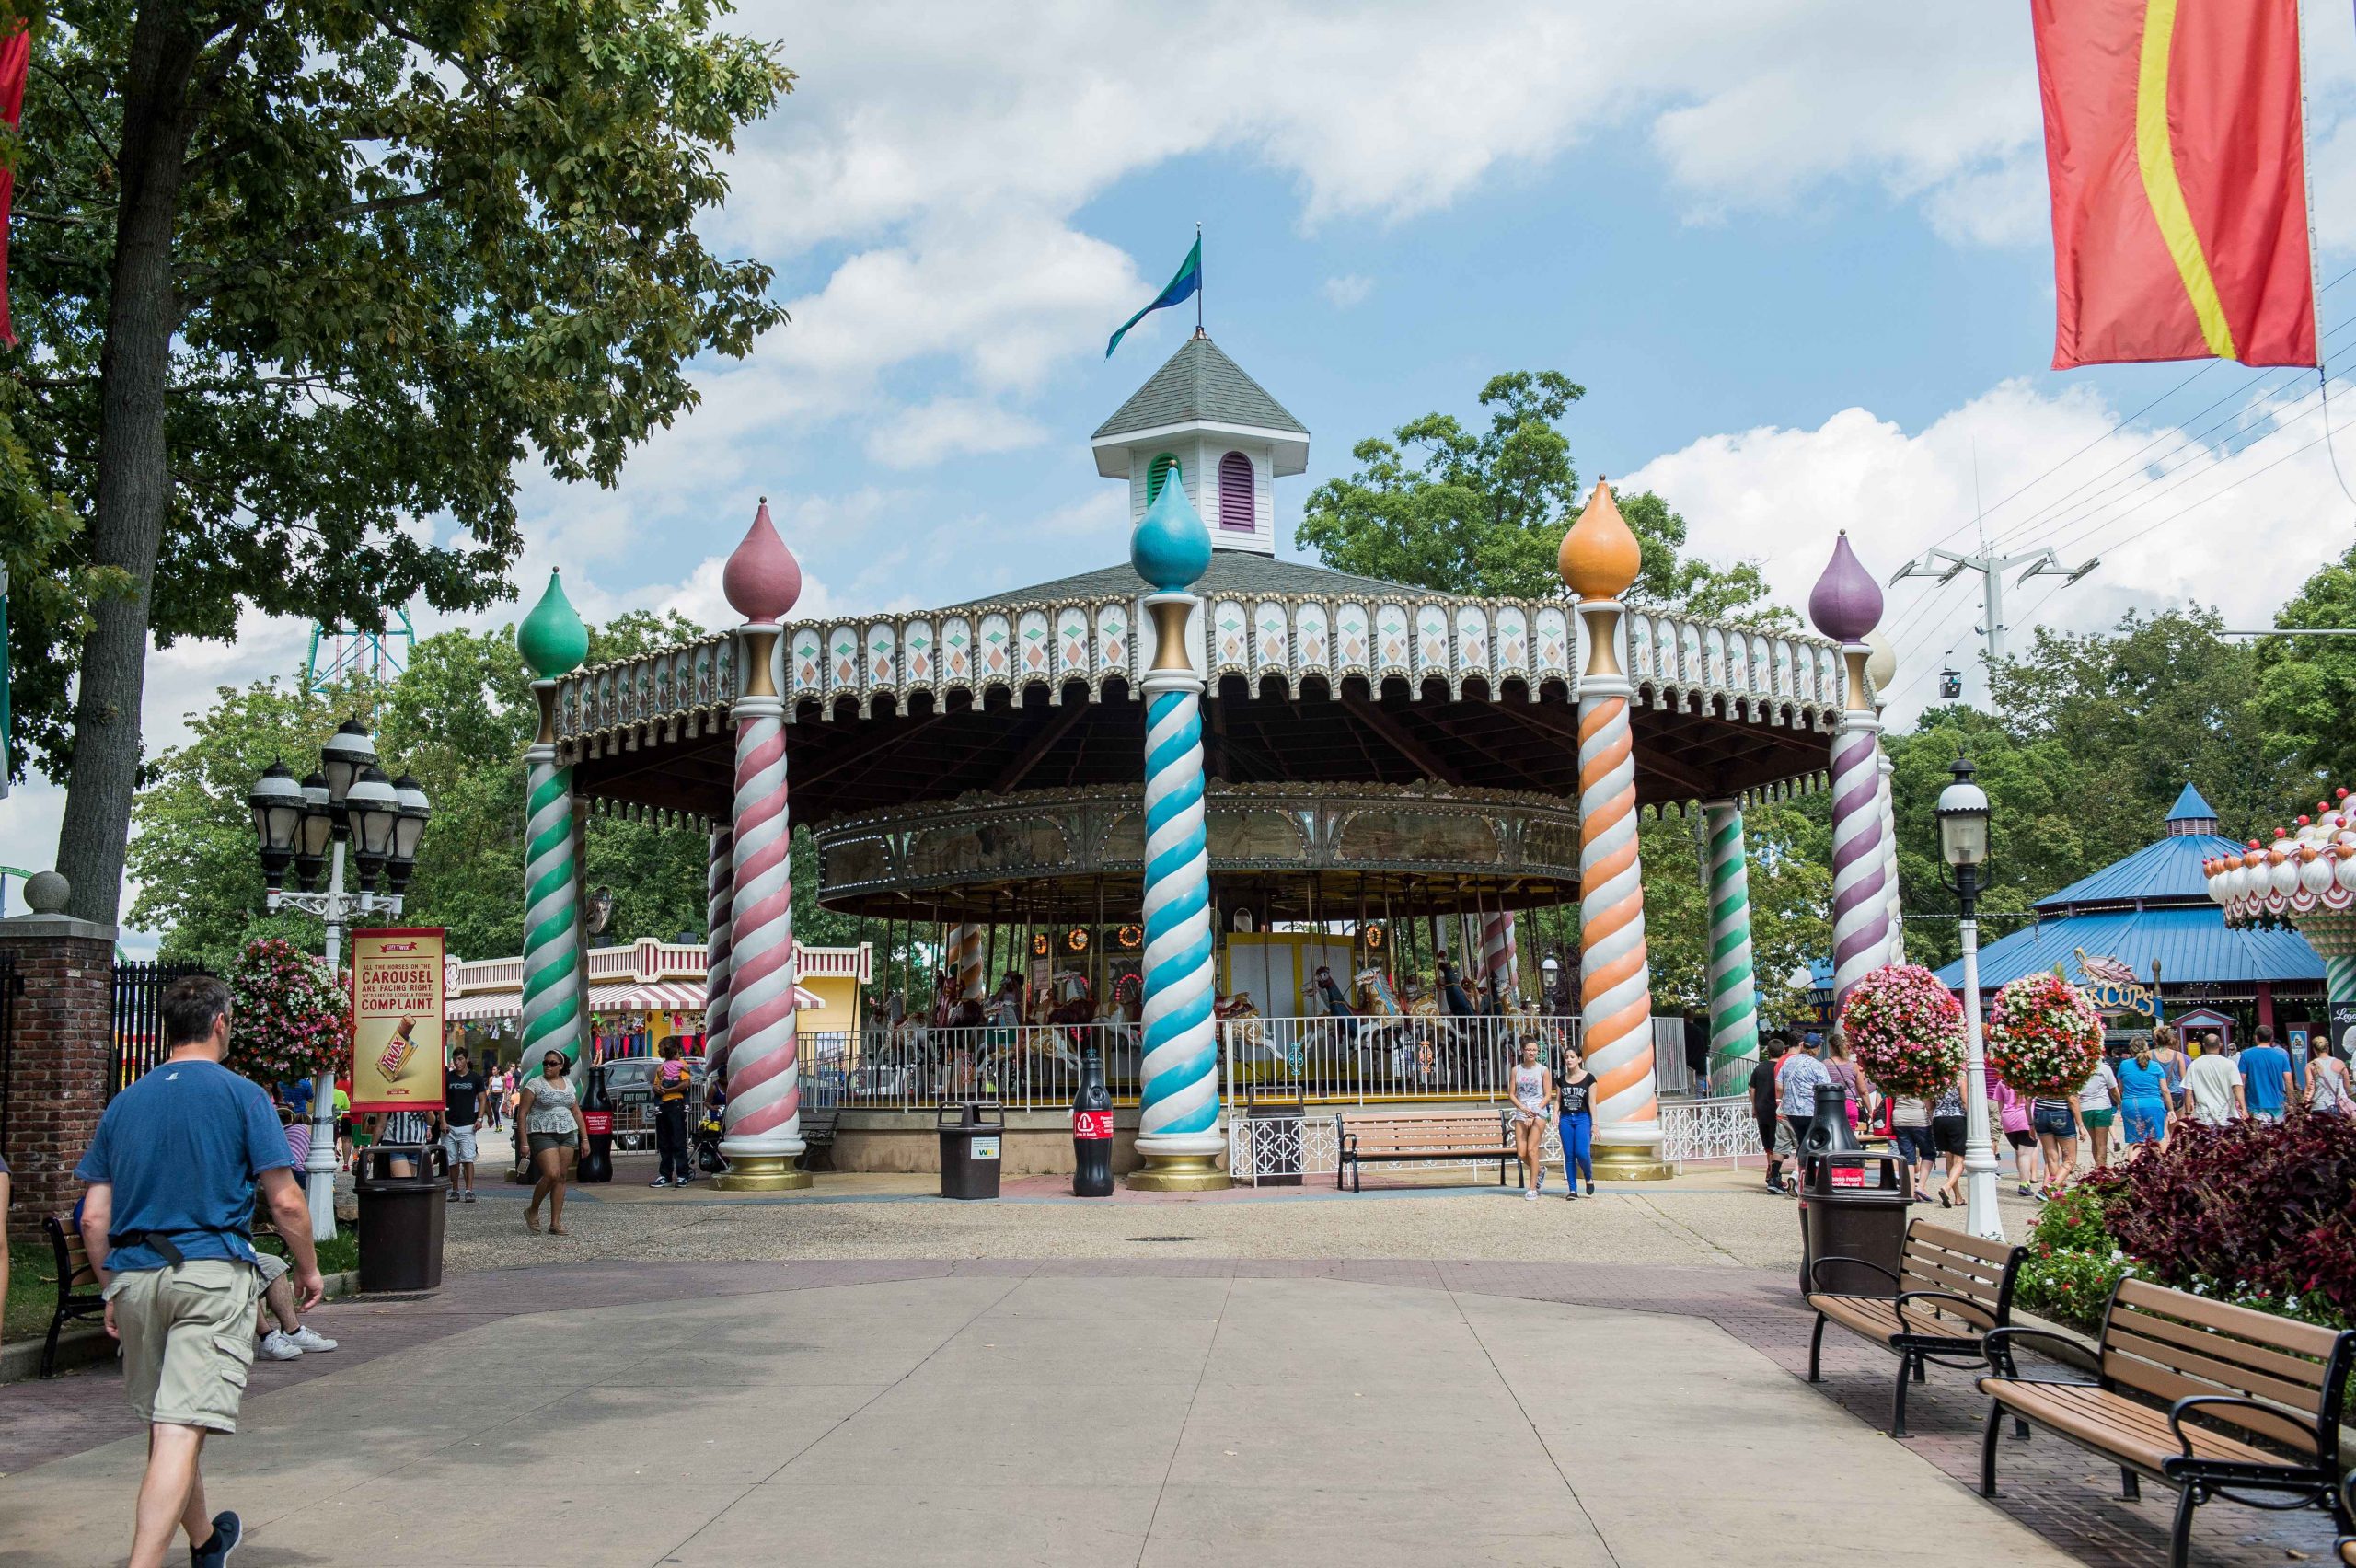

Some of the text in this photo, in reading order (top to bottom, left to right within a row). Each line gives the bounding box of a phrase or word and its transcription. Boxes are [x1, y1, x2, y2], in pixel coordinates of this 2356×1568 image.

[362, 970, 433, 985] CAROUSEL
[361, 997, 434, 1010] COMPLAINT.
[381, 1035, 405, 1072] TWIX
[623, 1092, 648, 1101] EXIT ONLY
[1573, 1087, 1587, 1097] YORK
